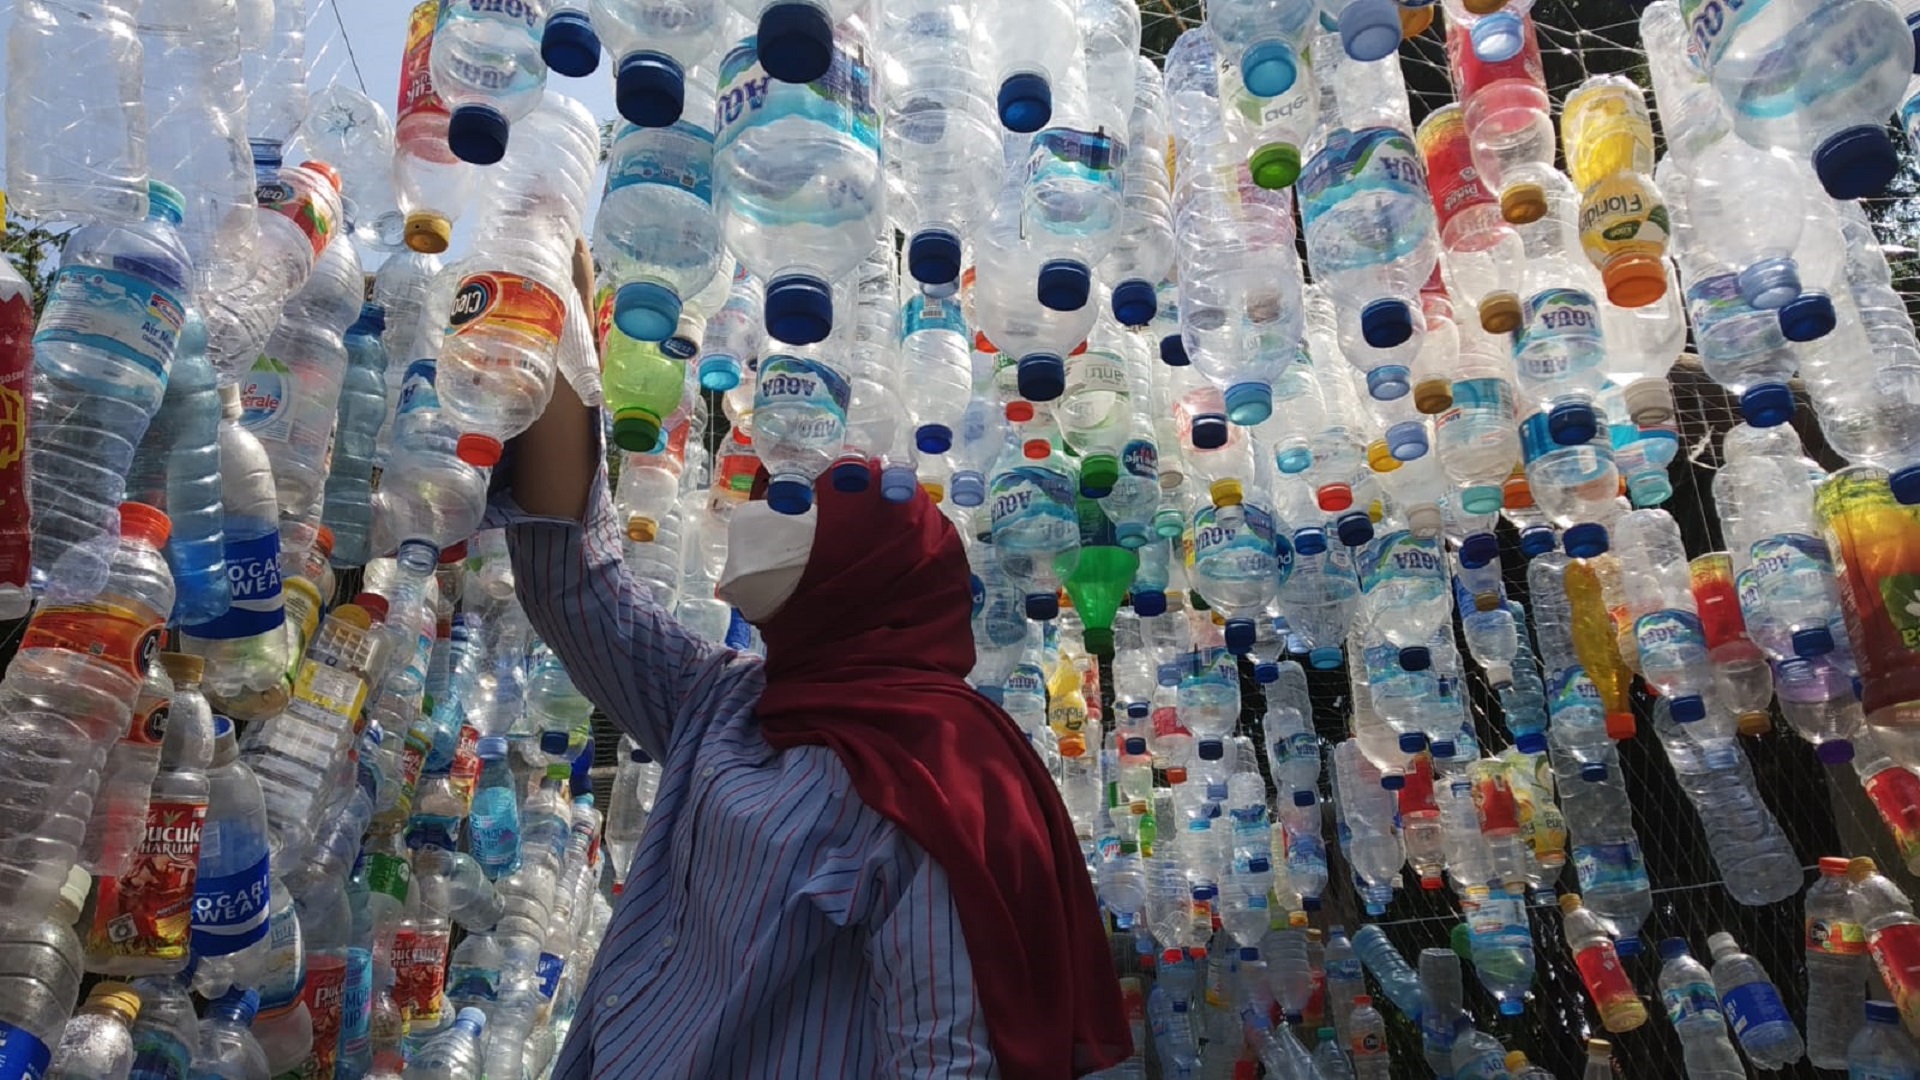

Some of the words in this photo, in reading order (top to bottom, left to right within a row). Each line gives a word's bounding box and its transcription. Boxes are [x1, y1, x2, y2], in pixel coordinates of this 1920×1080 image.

[243, 381, 257, 395] Le
[762, 374, 817, 398] AQUA
[241, 391, 279, 410] erale
[196, 875, 269, 911] OCARI
[191, 893, 265, 925] WEAT
